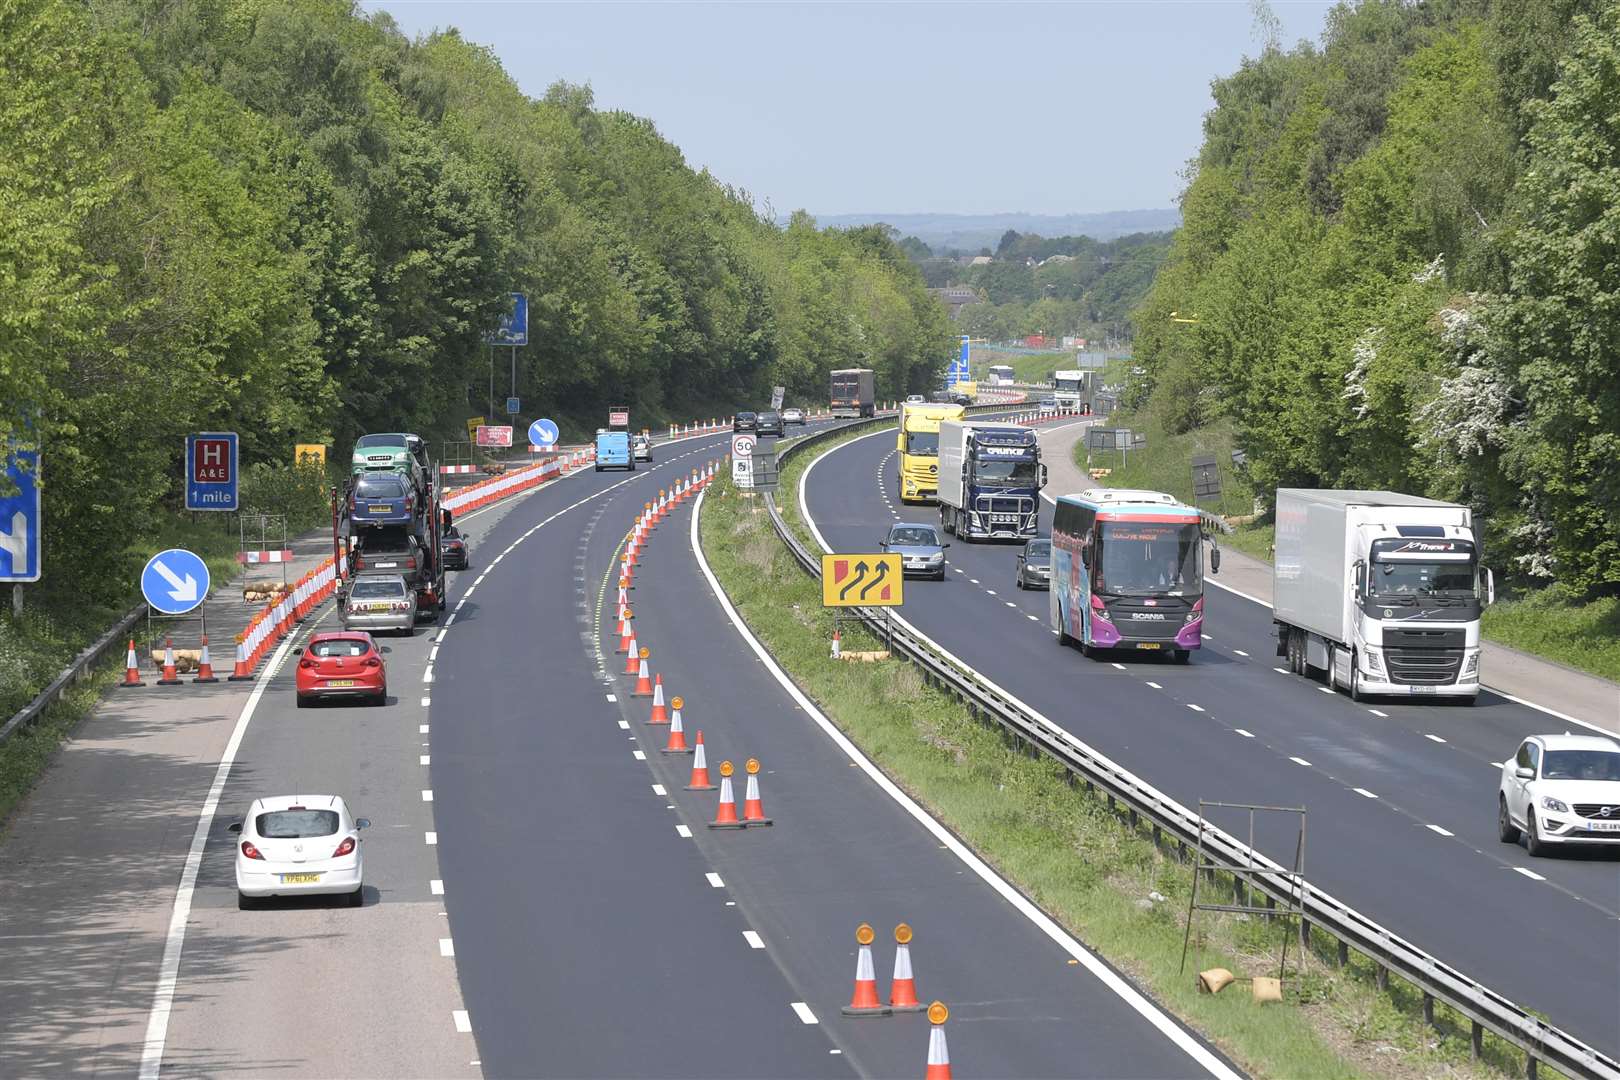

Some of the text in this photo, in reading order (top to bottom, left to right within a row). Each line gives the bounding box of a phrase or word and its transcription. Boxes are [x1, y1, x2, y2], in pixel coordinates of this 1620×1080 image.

[737, 442, 752, 451] 50
[203, 444, 221, 465] H
[192, 490, 232, 503] 1 mile
[1131, 612, 1165, 621] SCANIA
